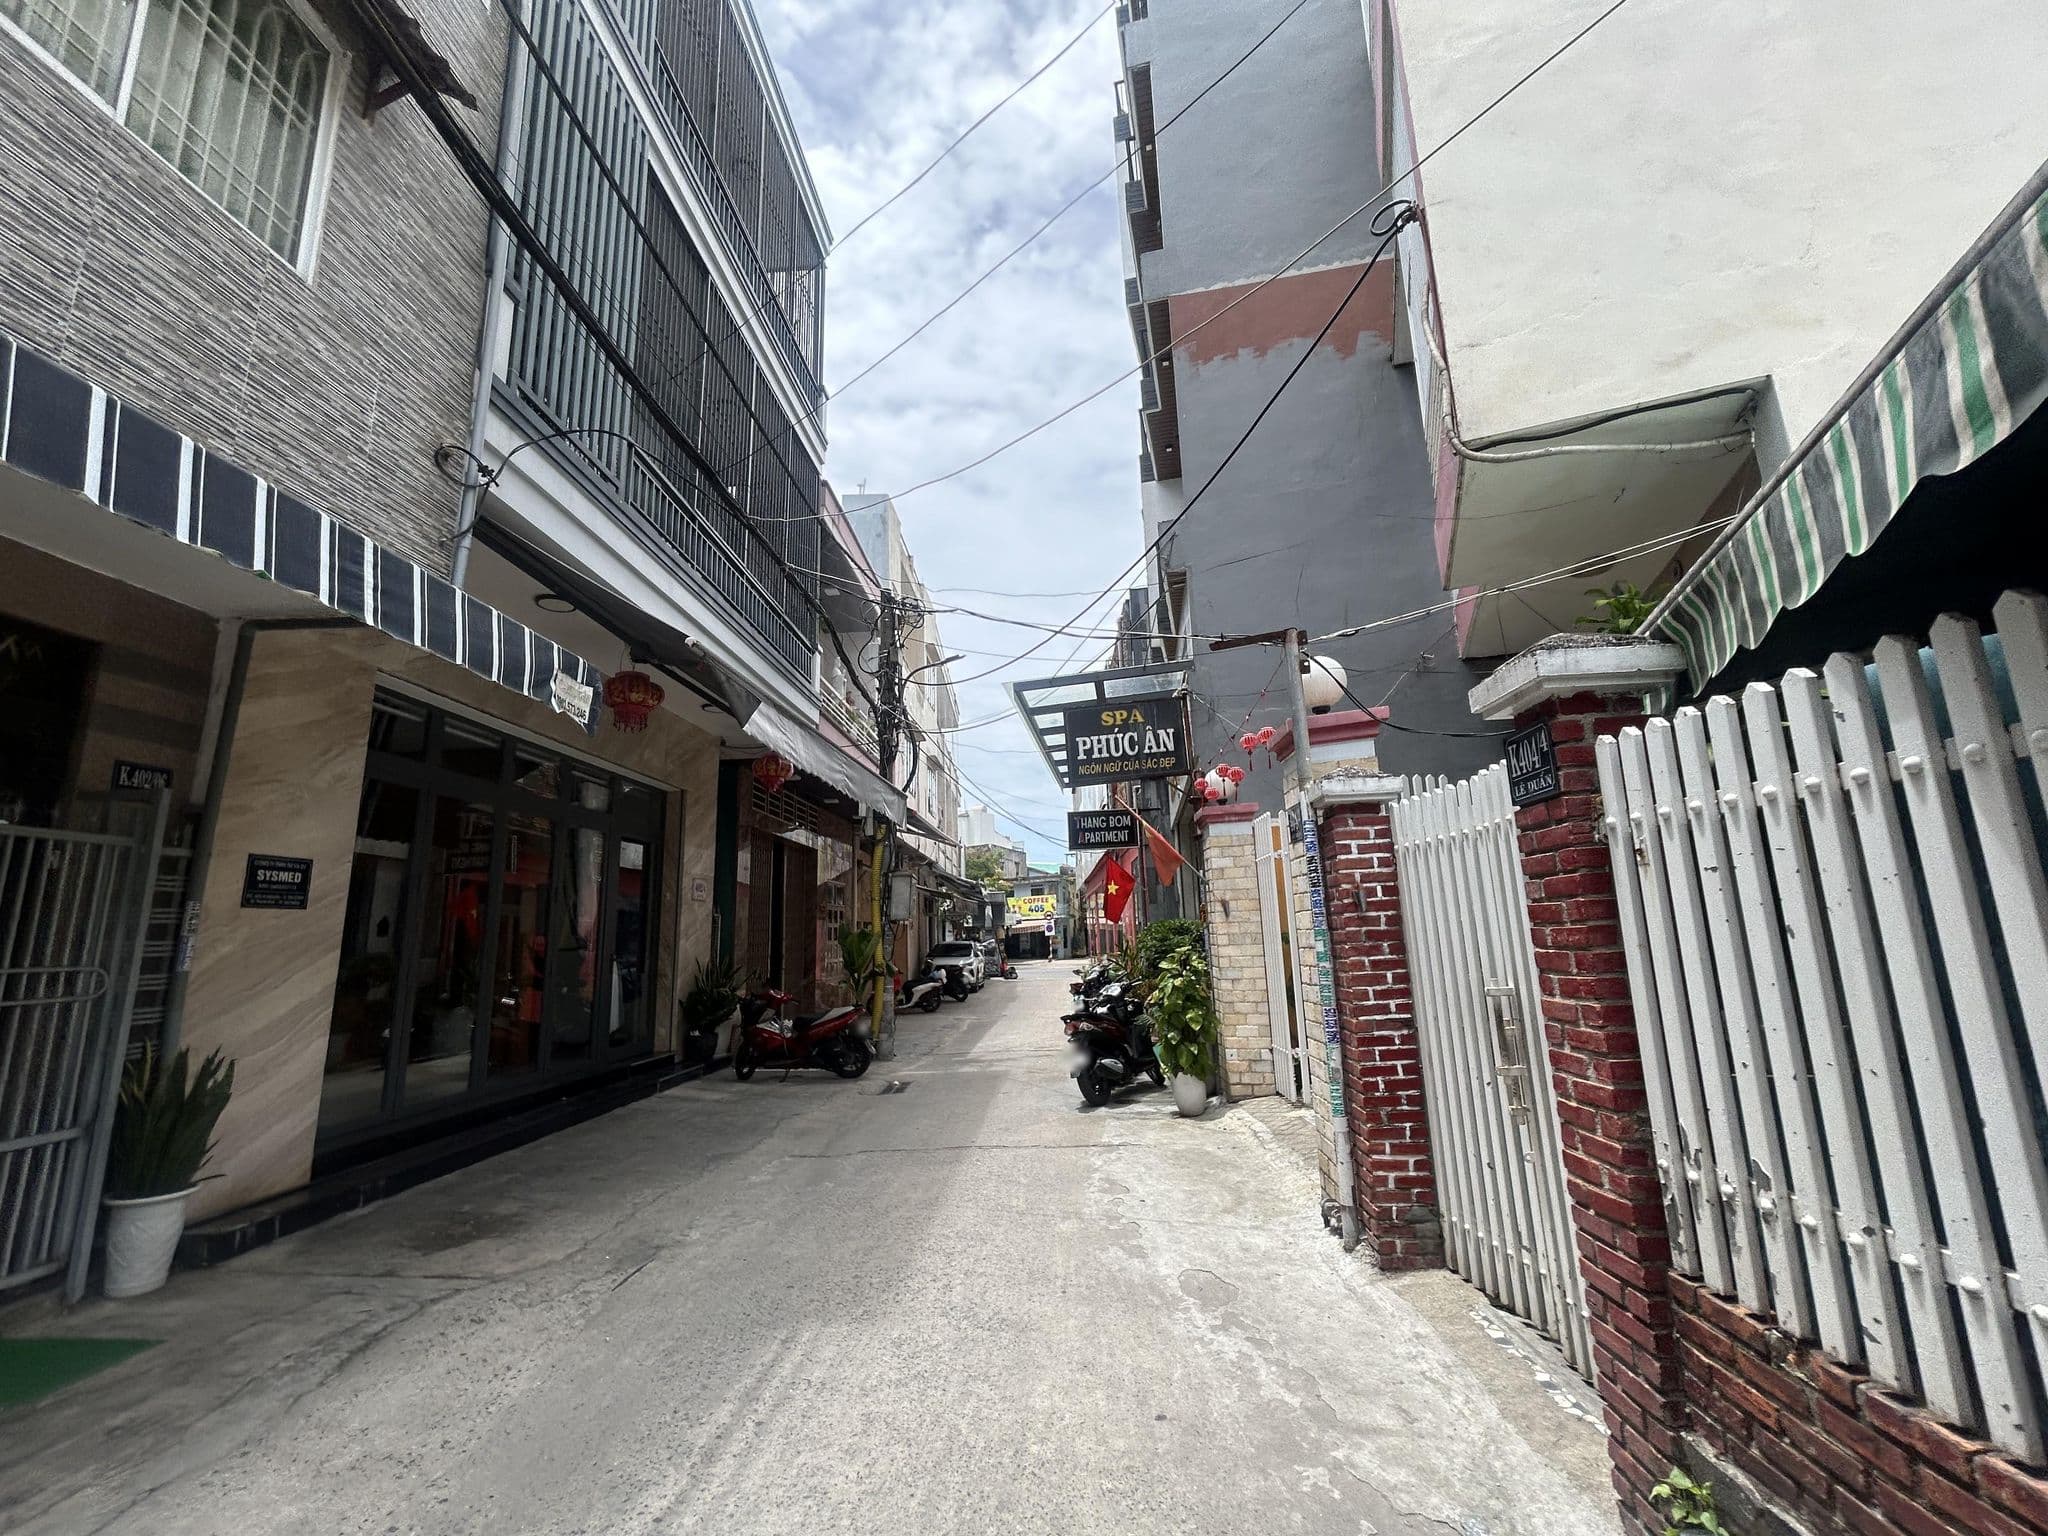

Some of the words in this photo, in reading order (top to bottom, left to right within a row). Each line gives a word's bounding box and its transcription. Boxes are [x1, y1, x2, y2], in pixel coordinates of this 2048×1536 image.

[1101, 708, 1145, 726] SPA
[1075, 727, 1139, 760] PHÚC
[1143, 725, 1175, 754] ÂN
[1507, 729, 1549, 778] K404/4
[1078, 830, 1129, 844] APARTMENT
[256, 869, 302, 883] SYSMED
[1023, 897, 1049, 905] COFFEE
[1028, 905, 1045, 913] 405
